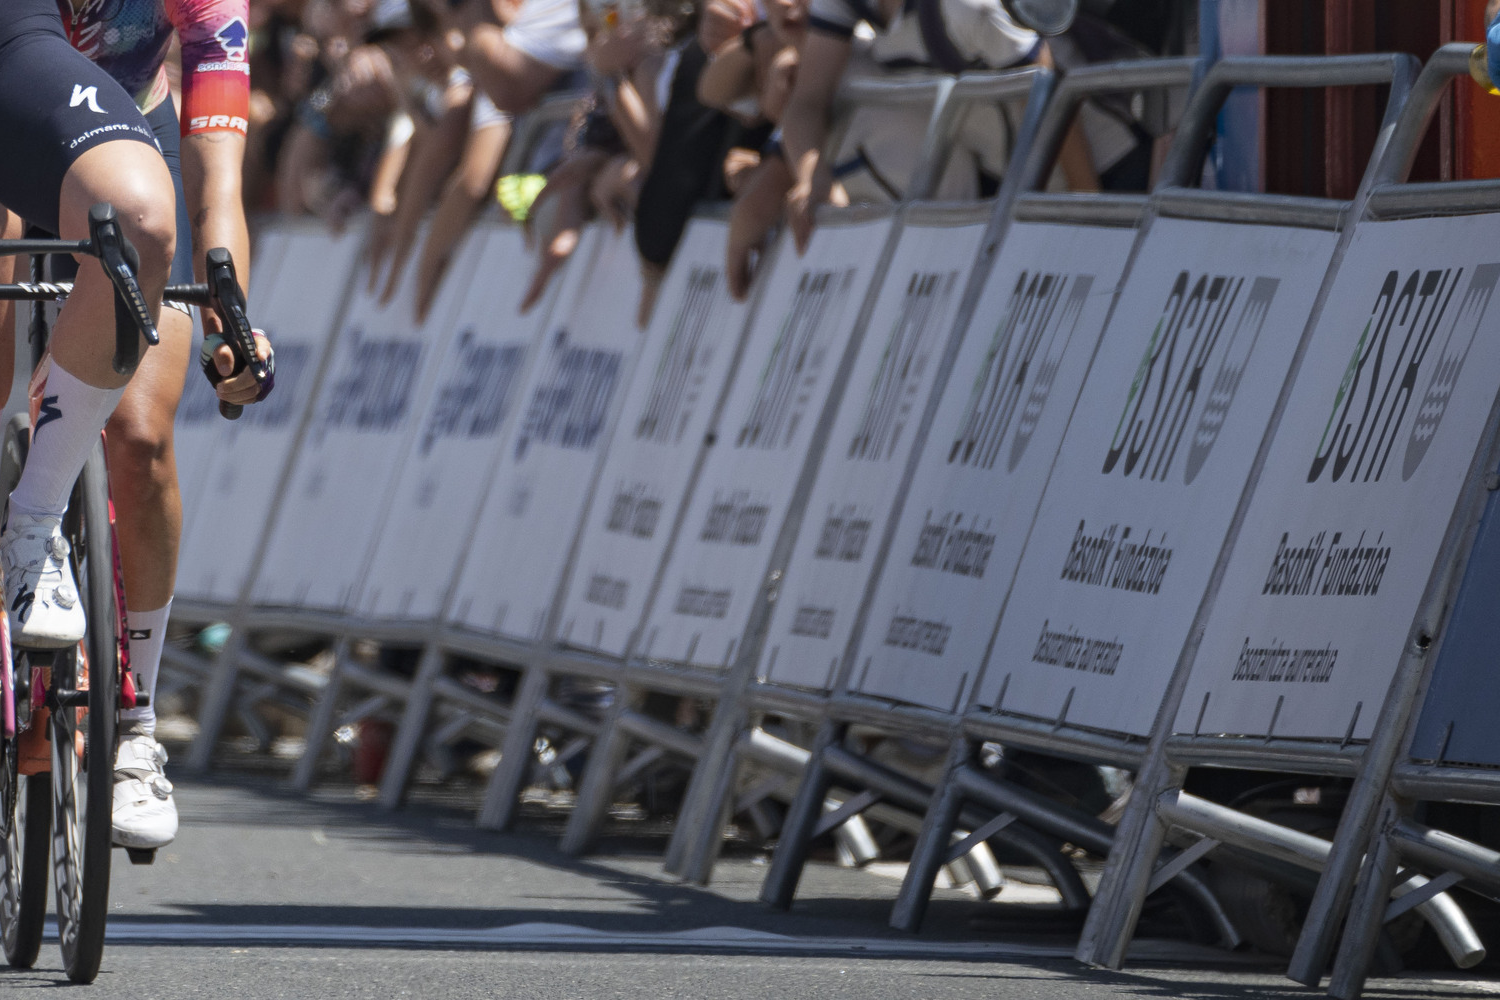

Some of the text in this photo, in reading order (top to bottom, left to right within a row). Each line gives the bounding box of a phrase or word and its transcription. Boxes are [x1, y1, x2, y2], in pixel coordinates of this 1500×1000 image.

[69, 123, 130, 149] dolmans
[1102, 268, 1246, 484] BSTK
[1306, 266, 1465, 484] BSTK
[1111, 525, 1174, 596] Fundazioa
[1262, 530, 1392, 598] Basotik Fundazioa
